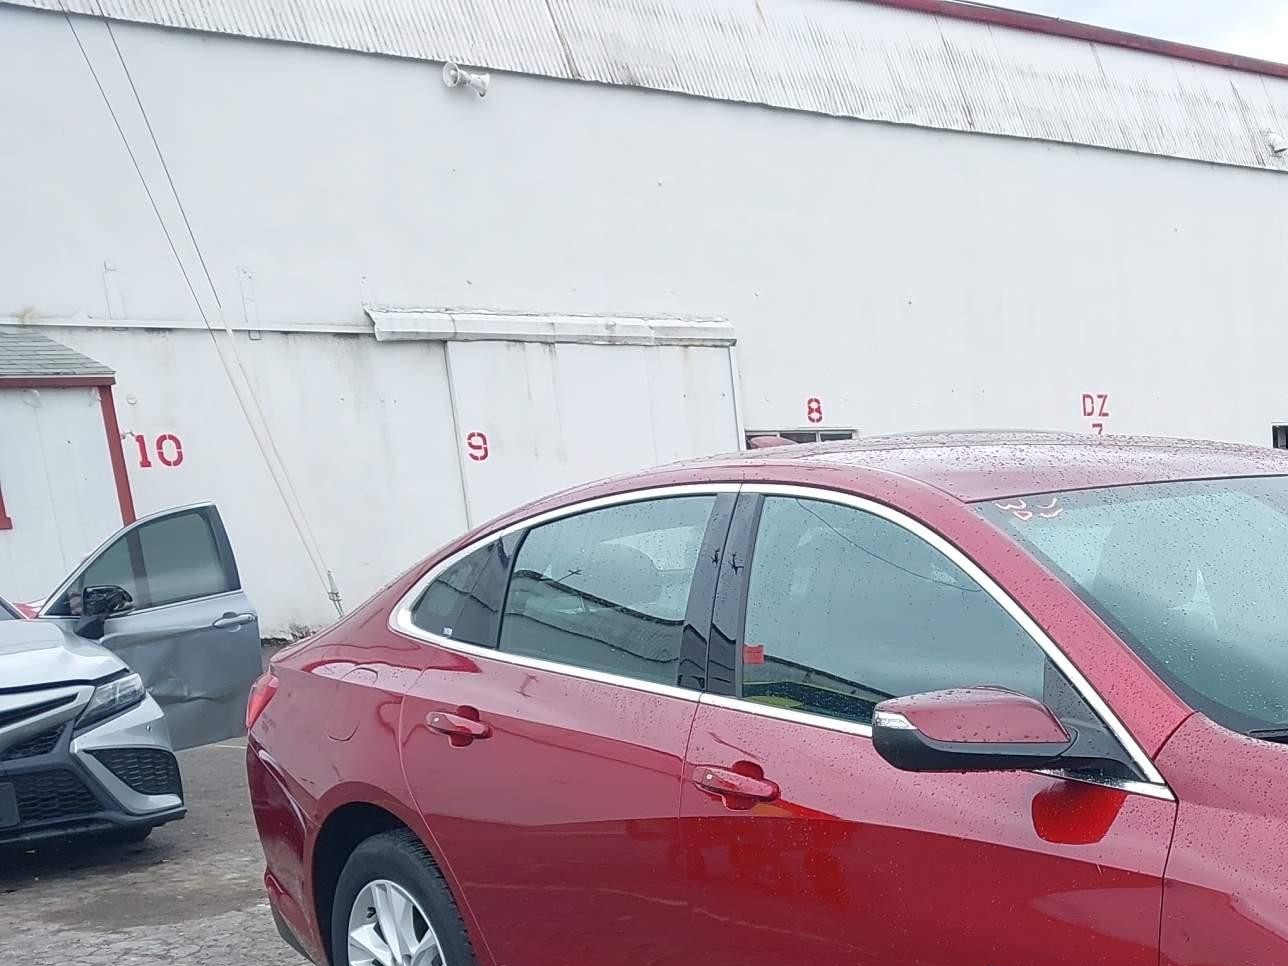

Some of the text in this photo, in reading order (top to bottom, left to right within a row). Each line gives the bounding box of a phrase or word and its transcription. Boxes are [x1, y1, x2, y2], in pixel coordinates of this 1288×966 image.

[807, 397, 823, 423] 8
[1082, 393, 1110, 417] DZ
[135, 433, 184, 468] 10
[467, 431, 489, 461] 9
